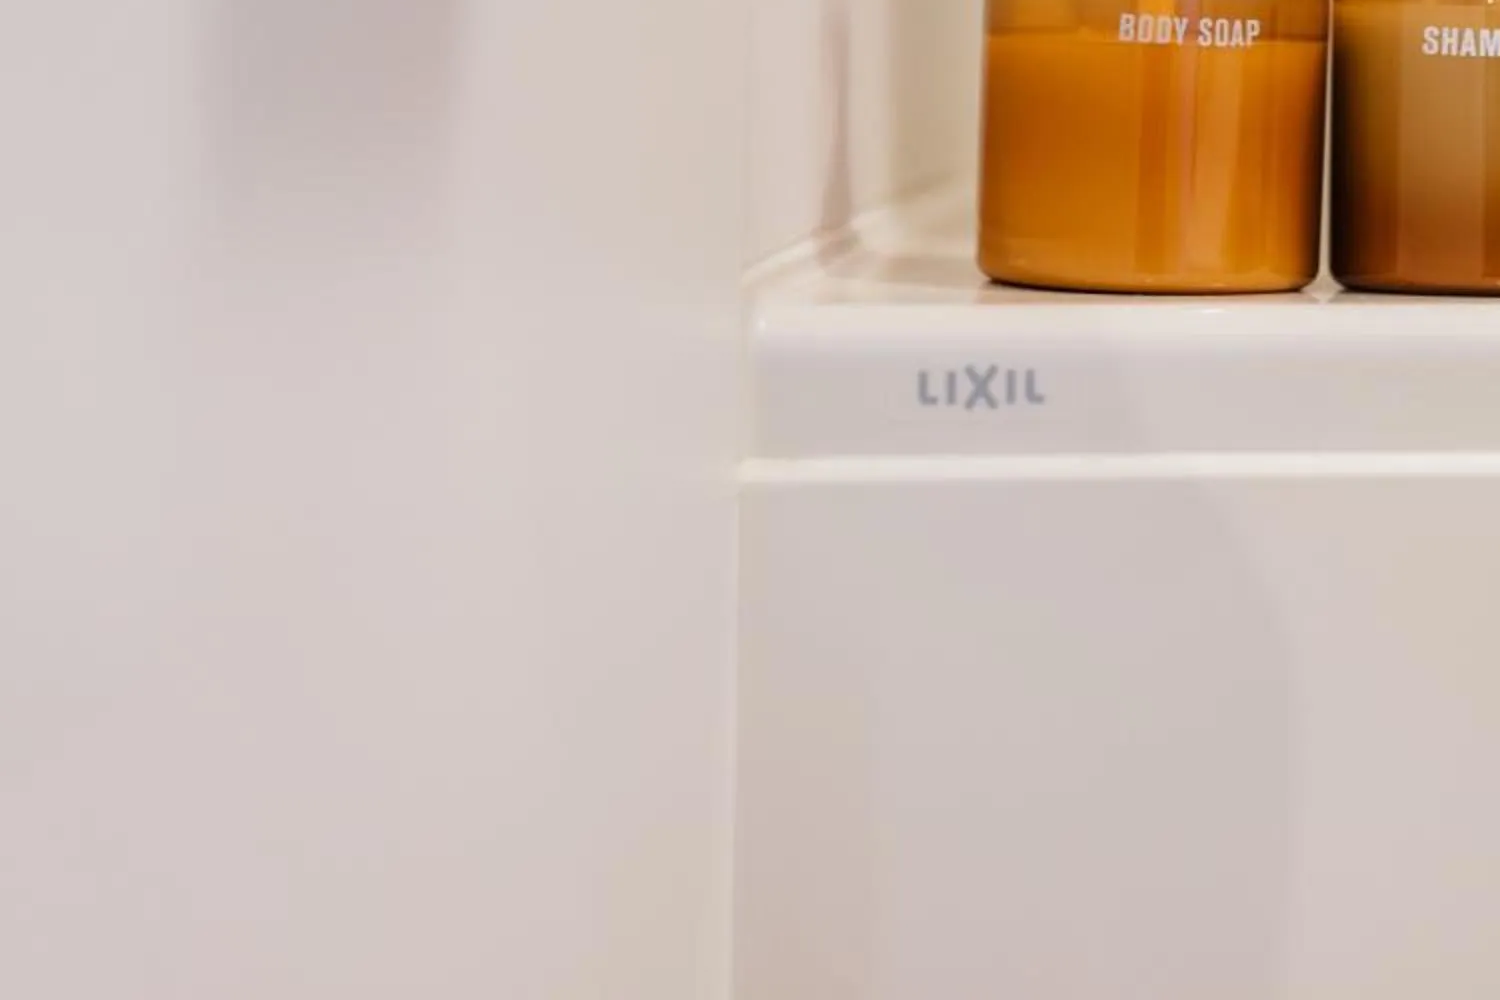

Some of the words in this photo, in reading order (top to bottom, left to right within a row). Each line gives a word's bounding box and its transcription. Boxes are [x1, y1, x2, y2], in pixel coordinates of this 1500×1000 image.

[1118, 12, 1189, 45] BODY
[1198, 17, 1261, 48] SOAP
[917, 364, 1046, 410] LIXIL
